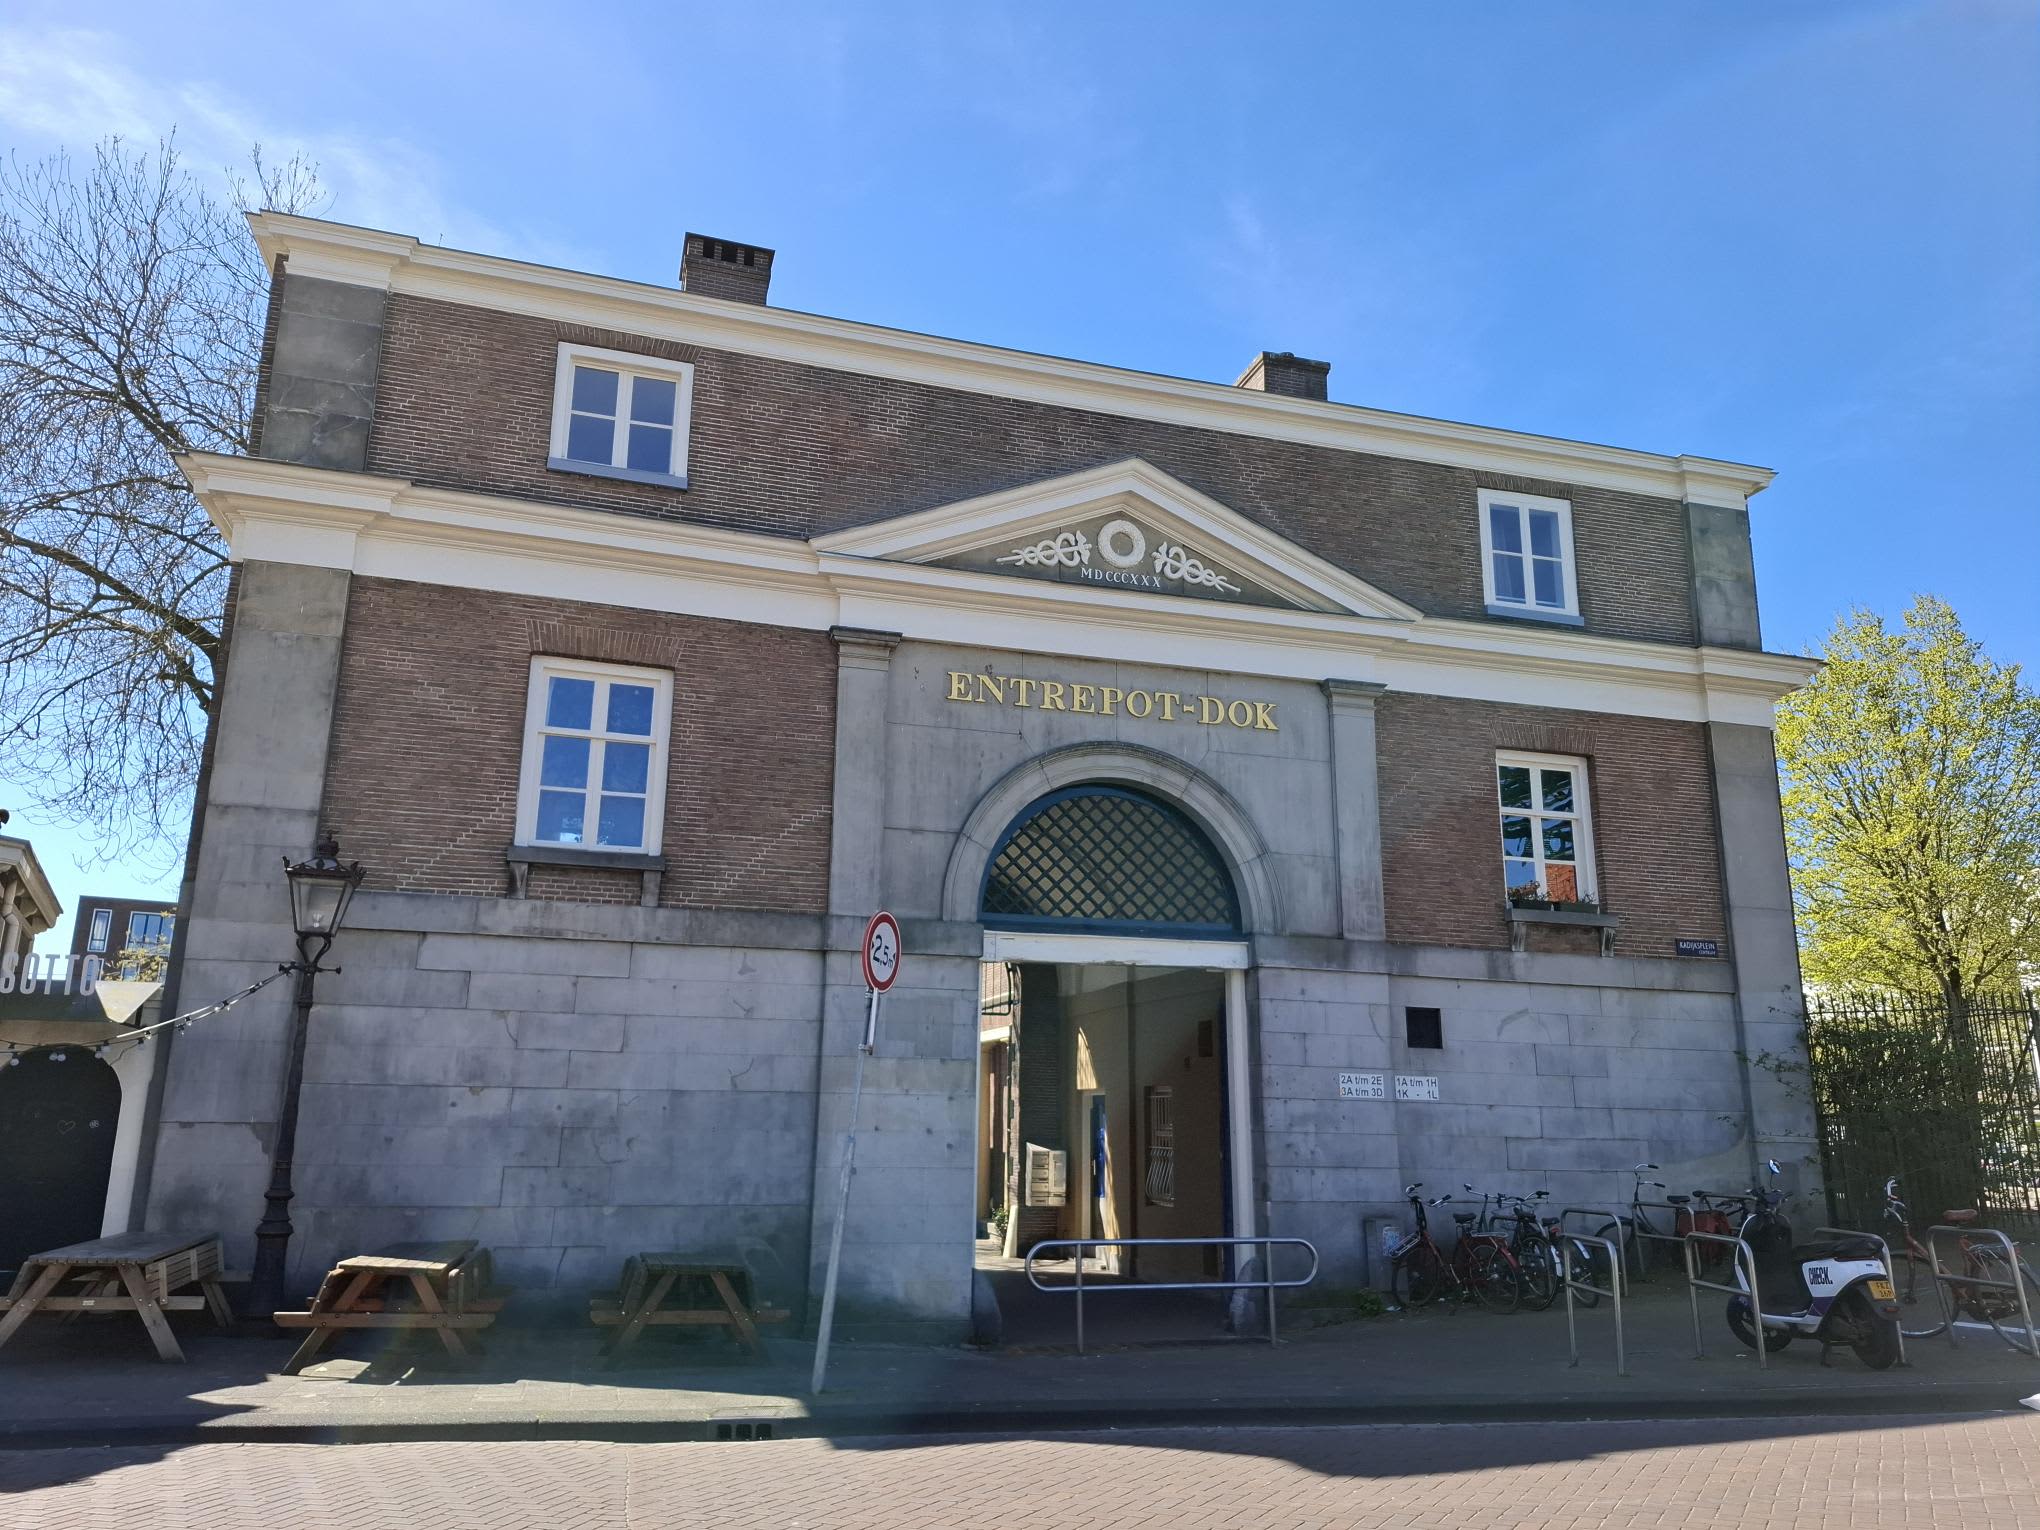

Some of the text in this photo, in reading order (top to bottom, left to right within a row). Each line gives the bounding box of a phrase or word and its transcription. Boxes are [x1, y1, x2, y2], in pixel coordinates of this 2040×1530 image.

[947, 671, 1279, 731] ENTREPOT-DOK
[0, 952, 100, 996] SOTTO
[1341, 1075, 1382, 1085] 2A t/m 2E
[1397, 1078, 1437, 1088] 1A t/m 1H
[1341, 1087, 1353, 1096] 3A
[1355, 1088, 1369, 1097] t/m
[1397, 1089, 1409, 1098] 1K
[1427, 1090, 1438, 1099] 1L
